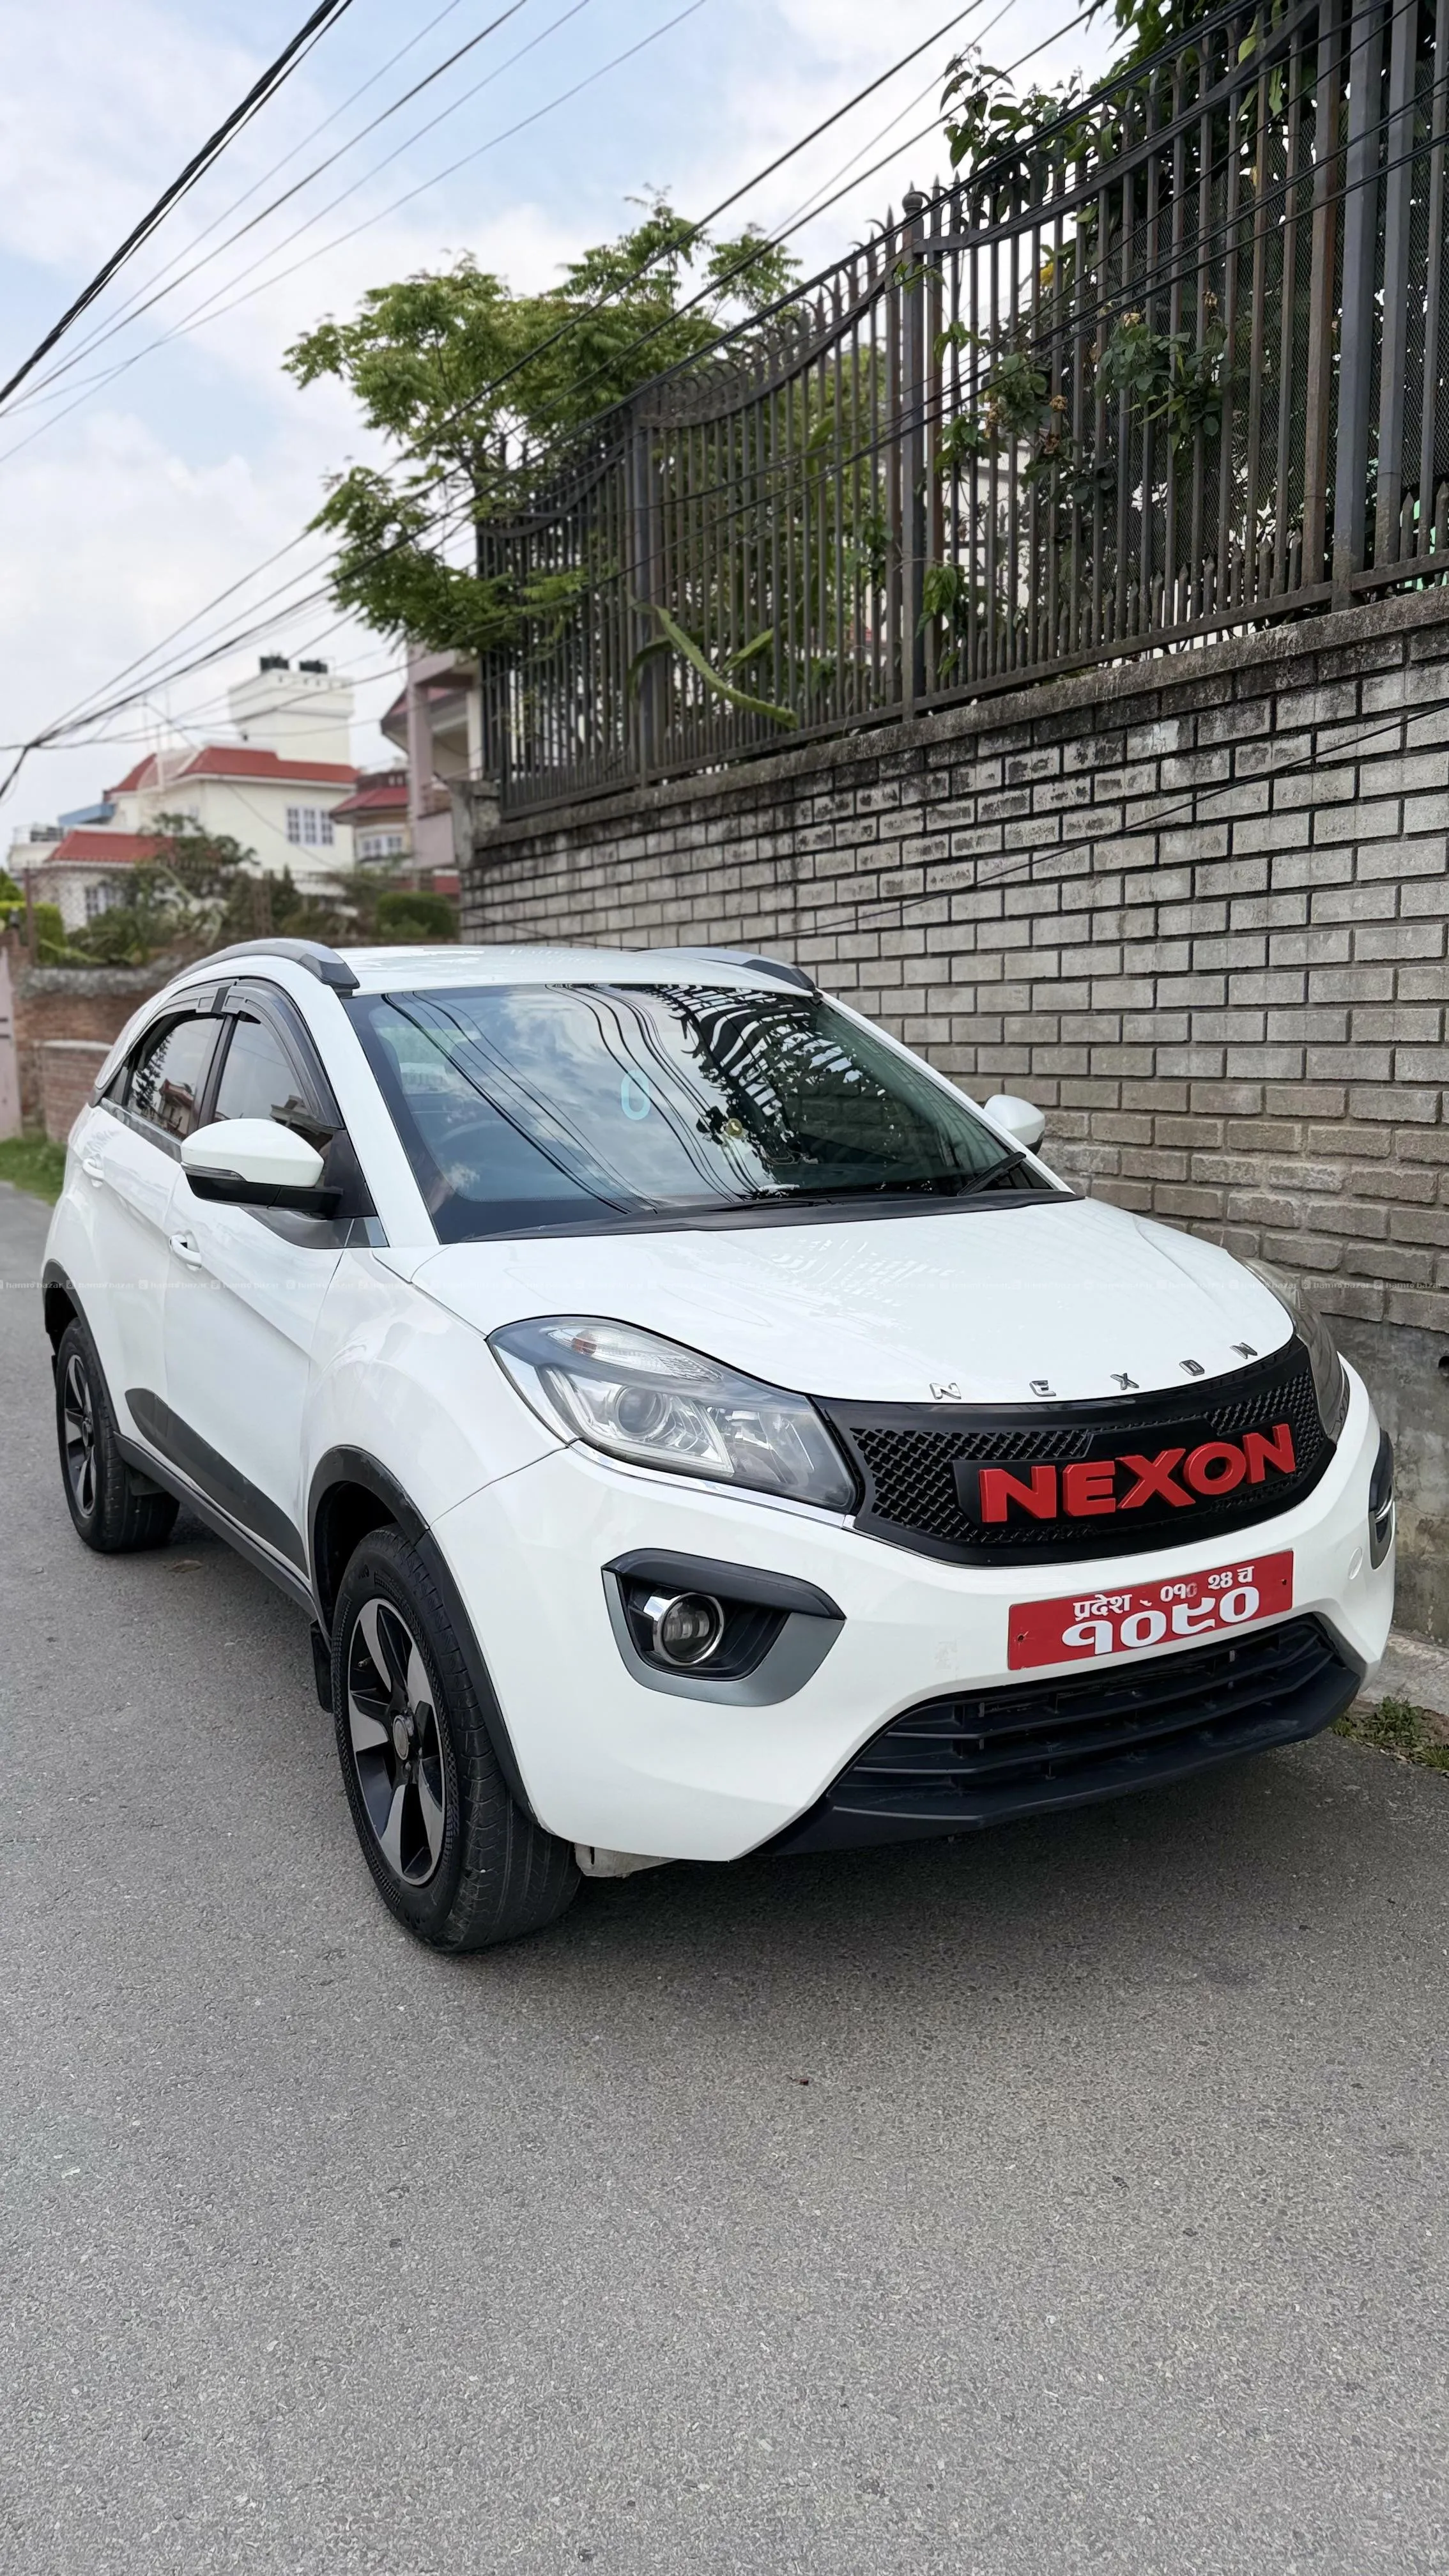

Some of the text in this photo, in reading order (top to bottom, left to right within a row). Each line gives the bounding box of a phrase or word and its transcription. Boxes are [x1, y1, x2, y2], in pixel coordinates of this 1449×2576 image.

[979, 1423, 1296, 1523] NEXON
[1061, 1586, 1260, 1655] १०९०
[1073, 1594, 1133, 1621] प्रदेश
[1236, 1565, 1255, 1583] च
